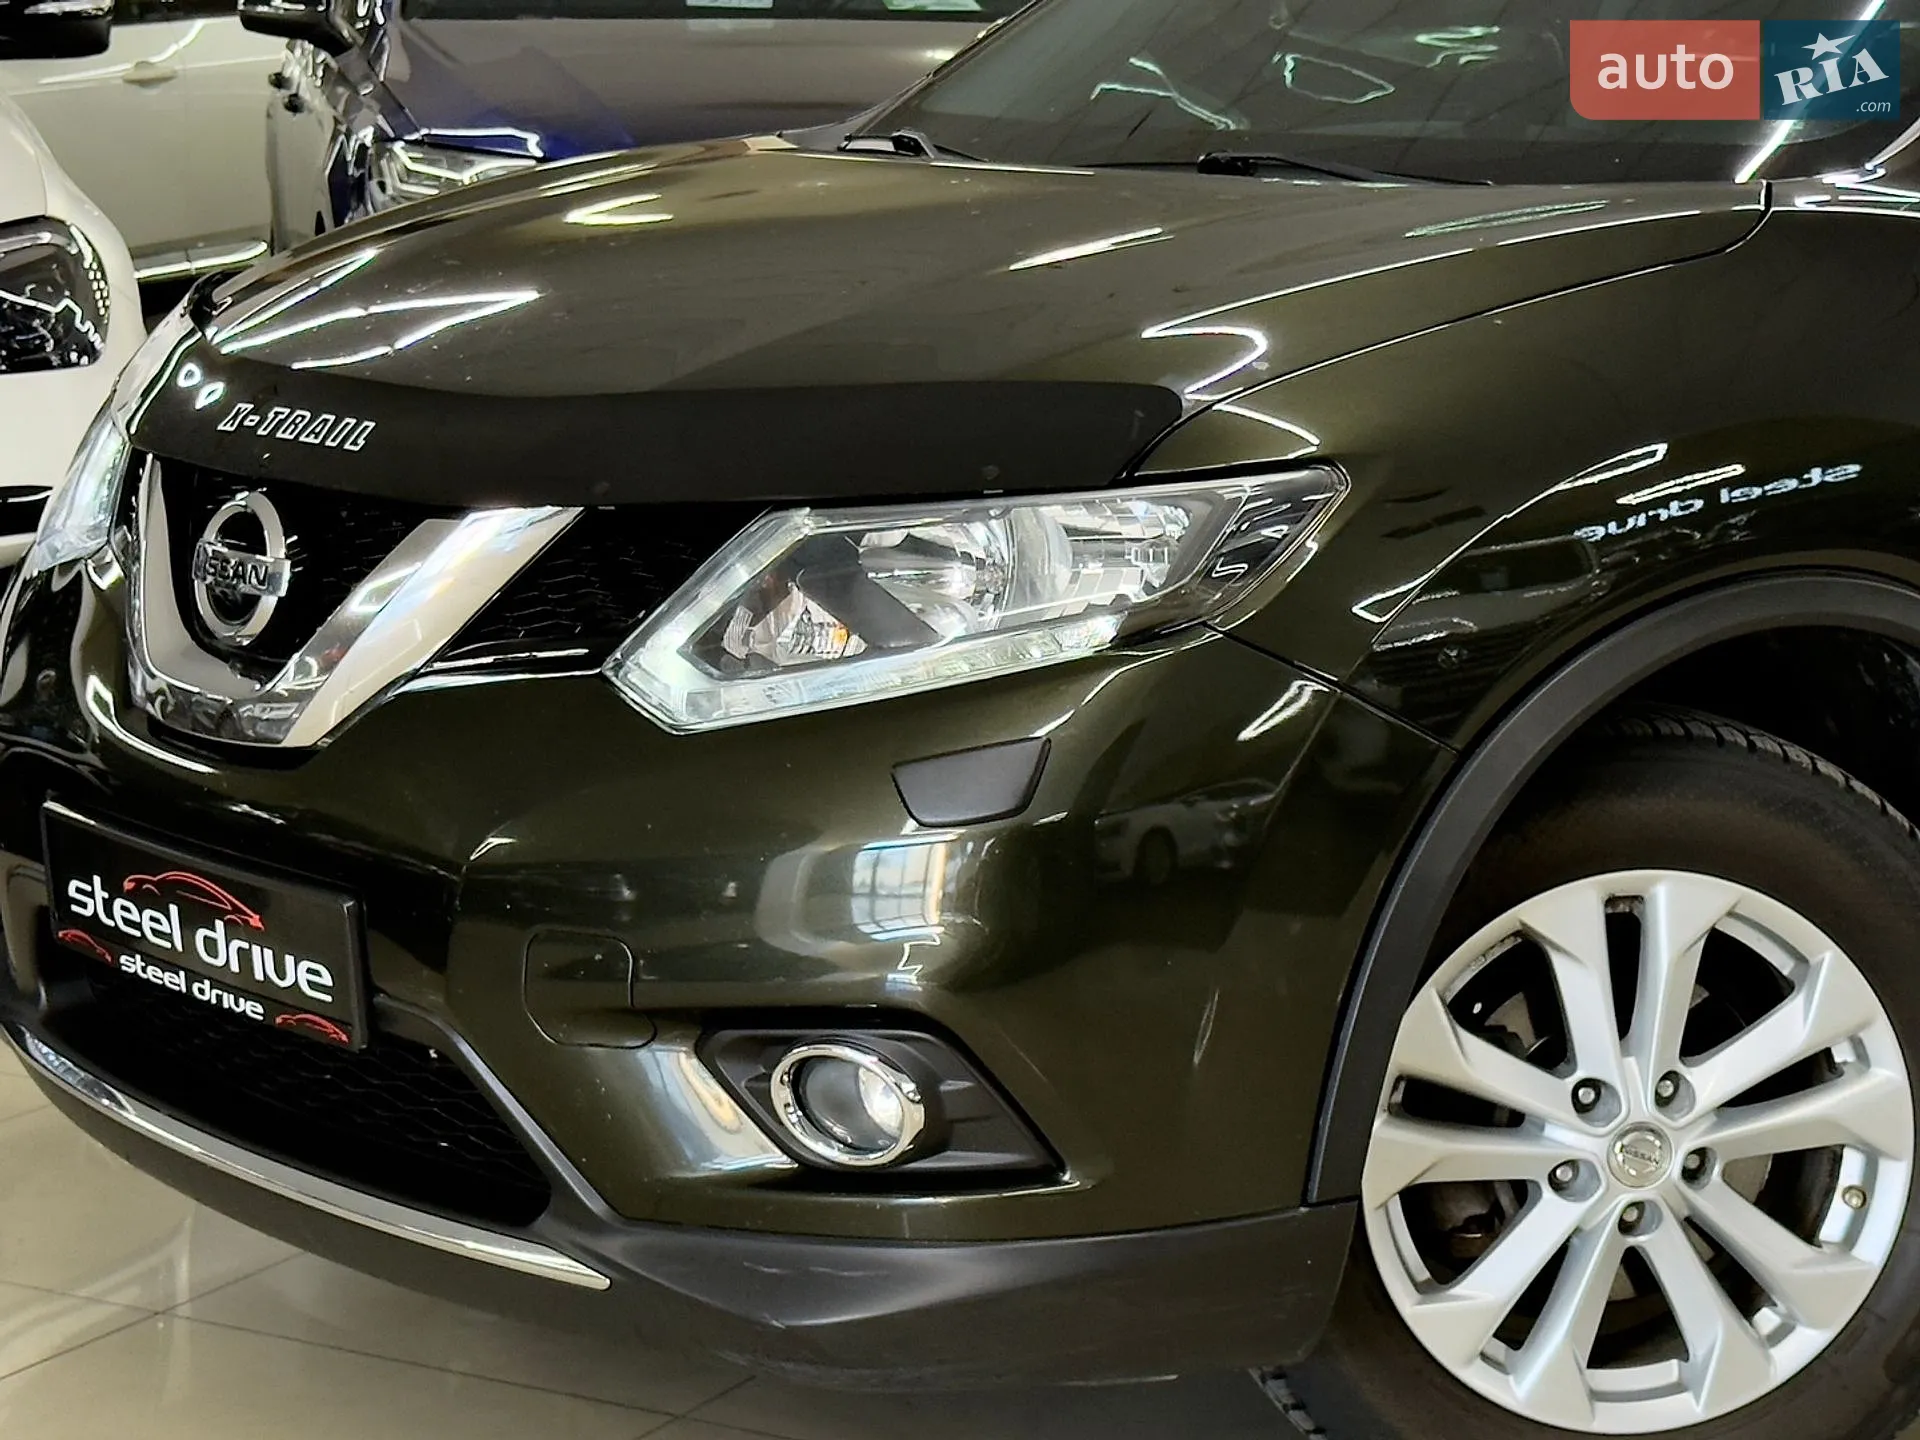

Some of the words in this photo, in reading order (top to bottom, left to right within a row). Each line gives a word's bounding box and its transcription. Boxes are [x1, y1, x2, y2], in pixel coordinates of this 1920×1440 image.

[217, 403, 376, 451] X-TRAIL
[195, 544, 268, 588] SSAN
[67, 875, 183, 952] steel
[194, 920, 333, 1002] drive
[119, 953, 186, 993] steel
[192, 979, 264, 1021] drive
